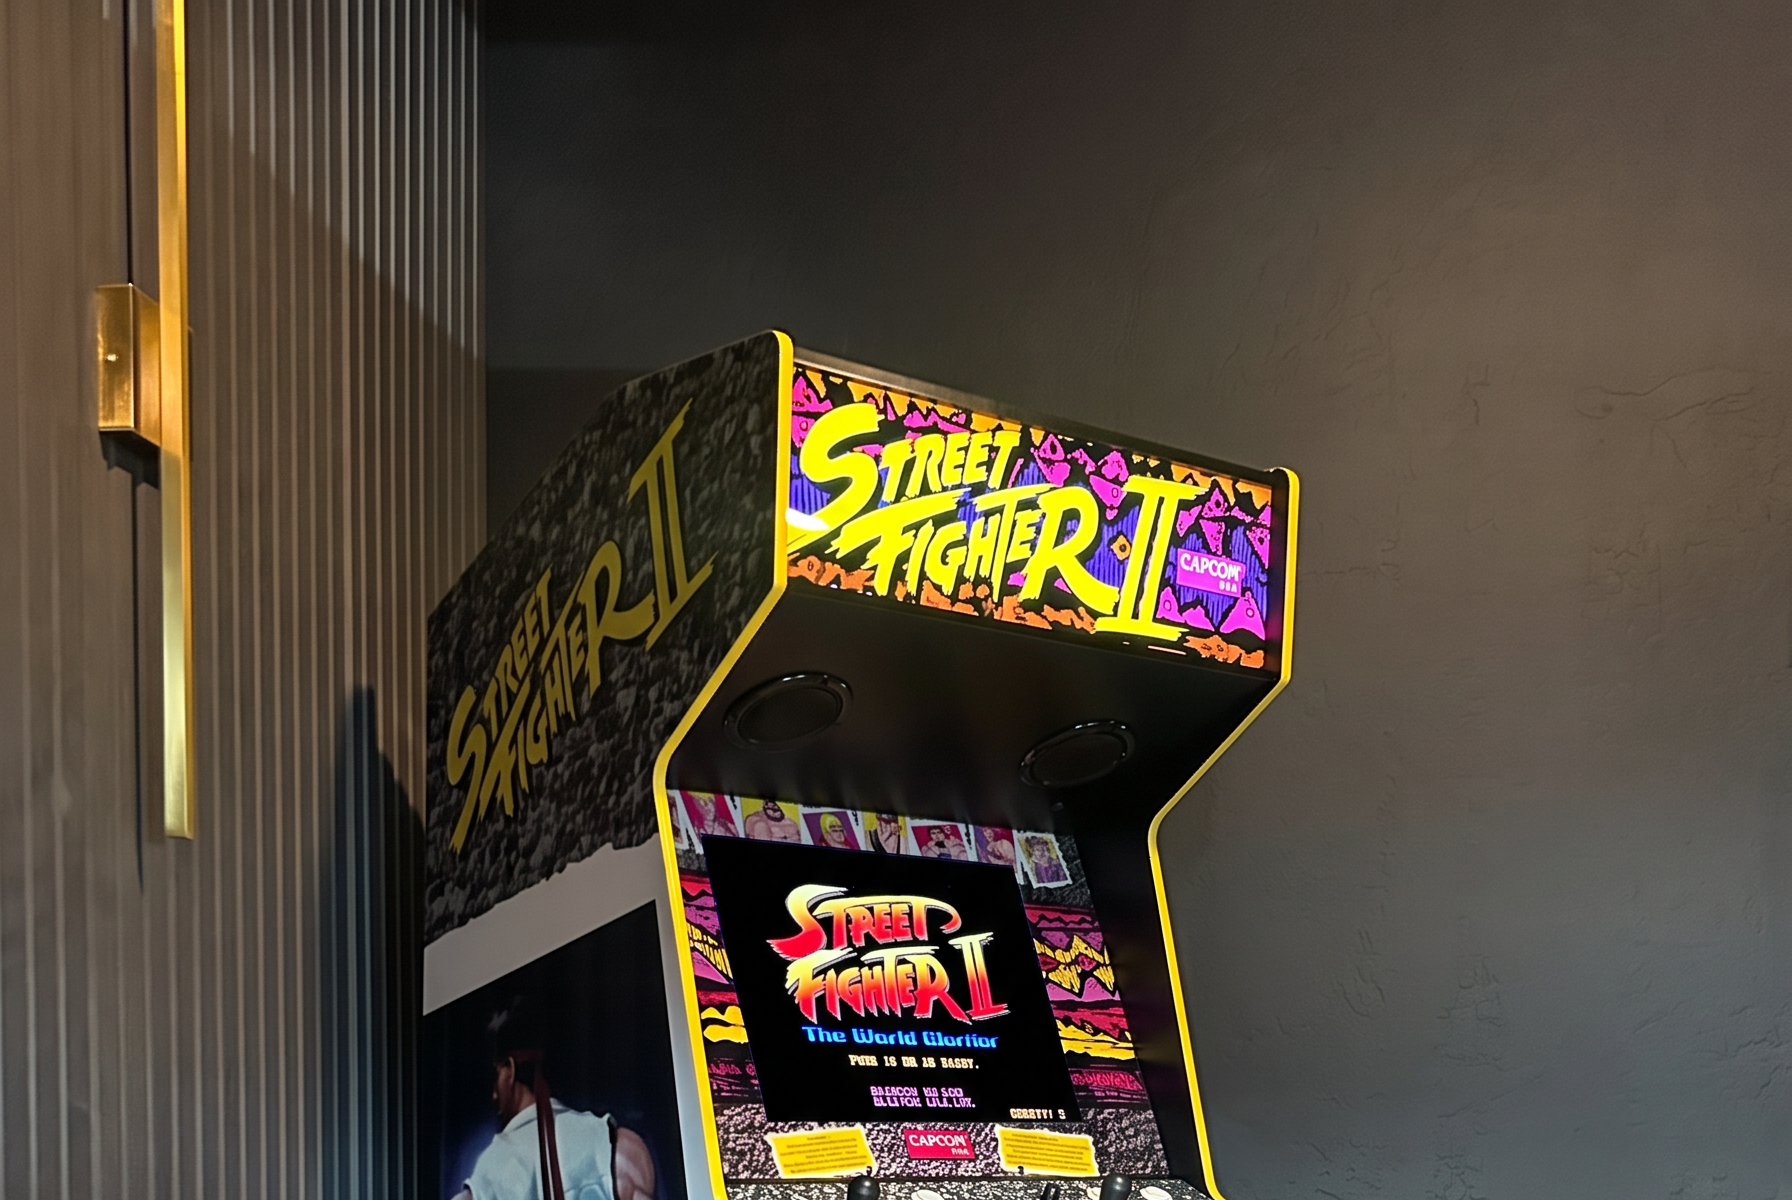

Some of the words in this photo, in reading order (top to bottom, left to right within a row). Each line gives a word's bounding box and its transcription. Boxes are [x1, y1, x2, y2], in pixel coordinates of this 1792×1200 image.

[786, 402, 1021, 554] STREET
[477, 540, 656, 822] FIGHTER
[627, 398, 719, 651] II
[830, 483, 1121, 615] FIGHTER
[1095, 474, 1207, 641] II
[1180, 552, 1242, 582] CAPCOM
[446, 564, 552, 853] STREET
[766, 883, 961, 960] STREET
[785, 945, 972, 1025] FIGHTER
[948, 931, 1012, 1021] II
[801, 1026, 847, 1043] The
